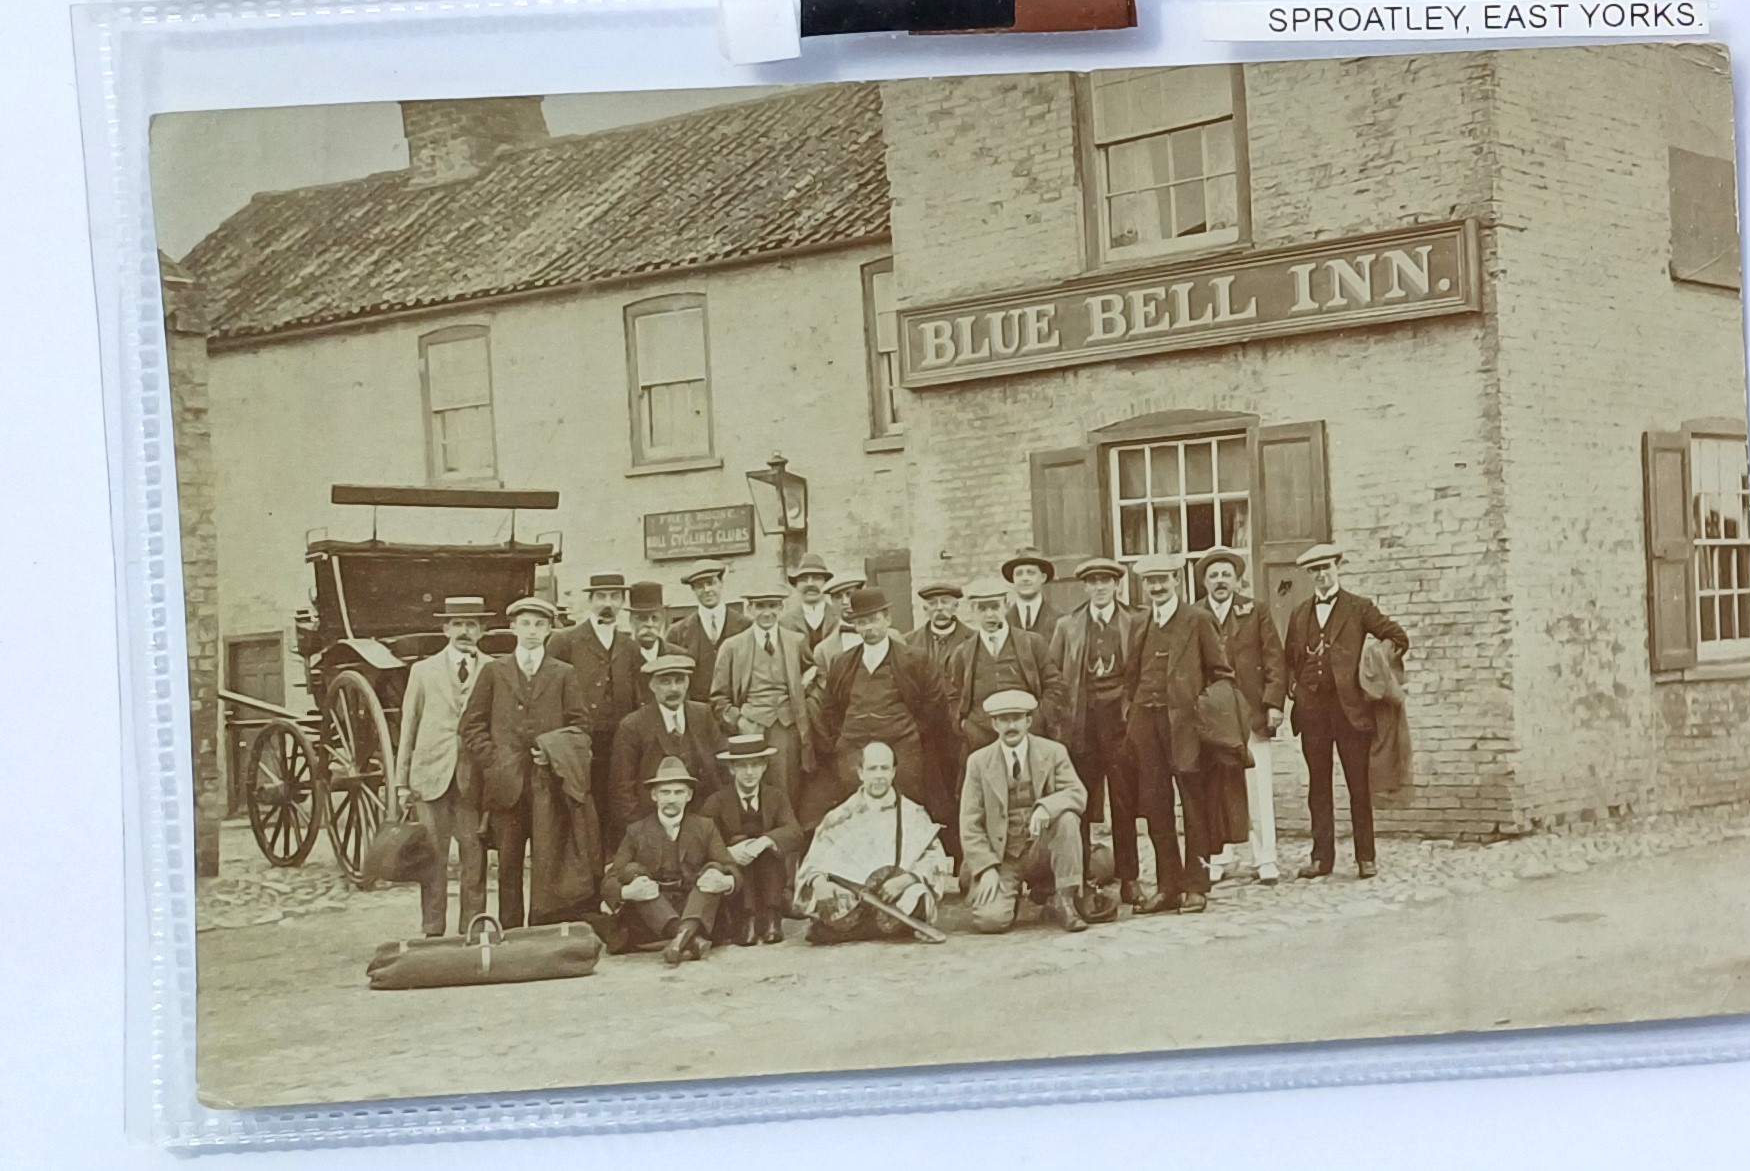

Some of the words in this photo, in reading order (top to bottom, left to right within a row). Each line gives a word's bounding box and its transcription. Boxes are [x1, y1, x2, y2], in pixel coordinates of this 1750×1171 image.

[1268, 5, 1470, 34] SPROATLEY,
[1483, 3, 1569, 30] EAST
[1579, 2, 1703, 28] YORKS.
[917, 303, 1062, 369] BLUE
[1082, 274, 1258, 348] BELL
[1286, 243, 1452, 315] INN.
[671, 530, 713, 547] CYCLING
[716, 528, 750, 543] CLUBS
